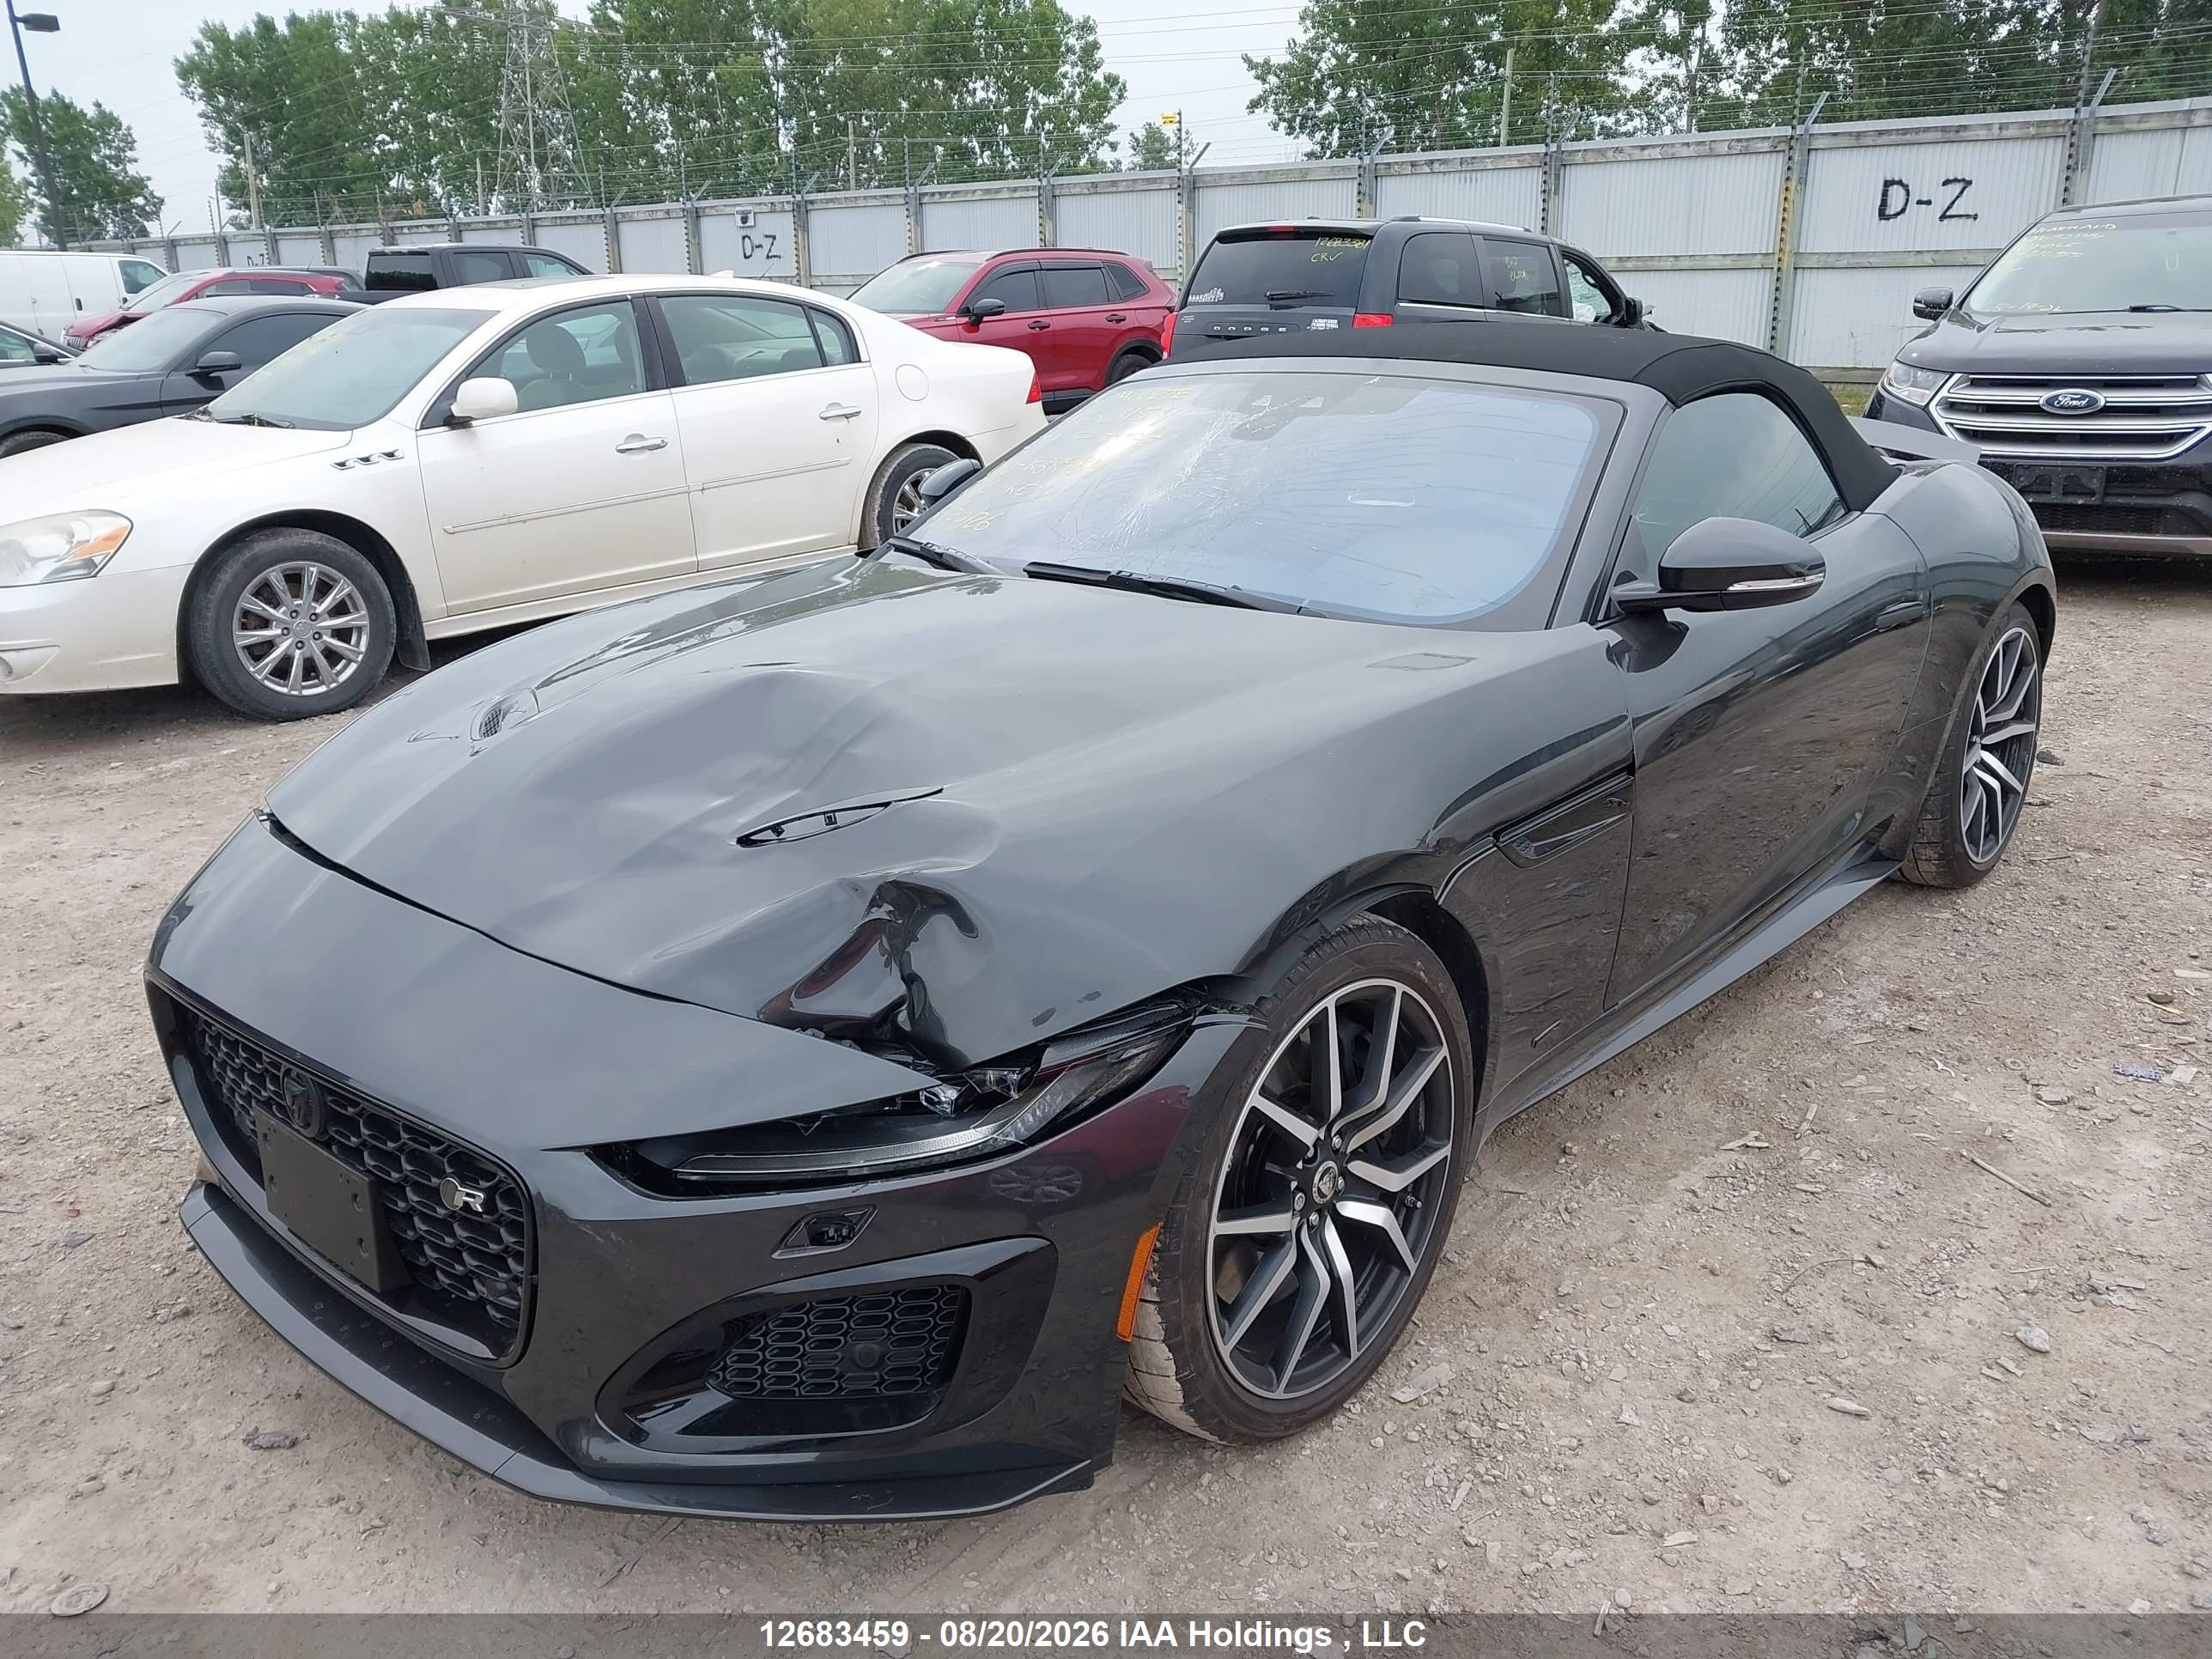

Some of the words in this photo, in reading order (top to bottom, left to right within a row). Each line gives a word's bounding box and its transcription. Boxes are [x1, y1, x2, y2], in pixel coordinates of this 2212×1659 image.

[1878, 177, 1978, 222] D-Z
[742, 234, 781, 259] D-Z
[1310, 252, 1345, 263] CRV
[2053, 394, 2089, 407] Ford
